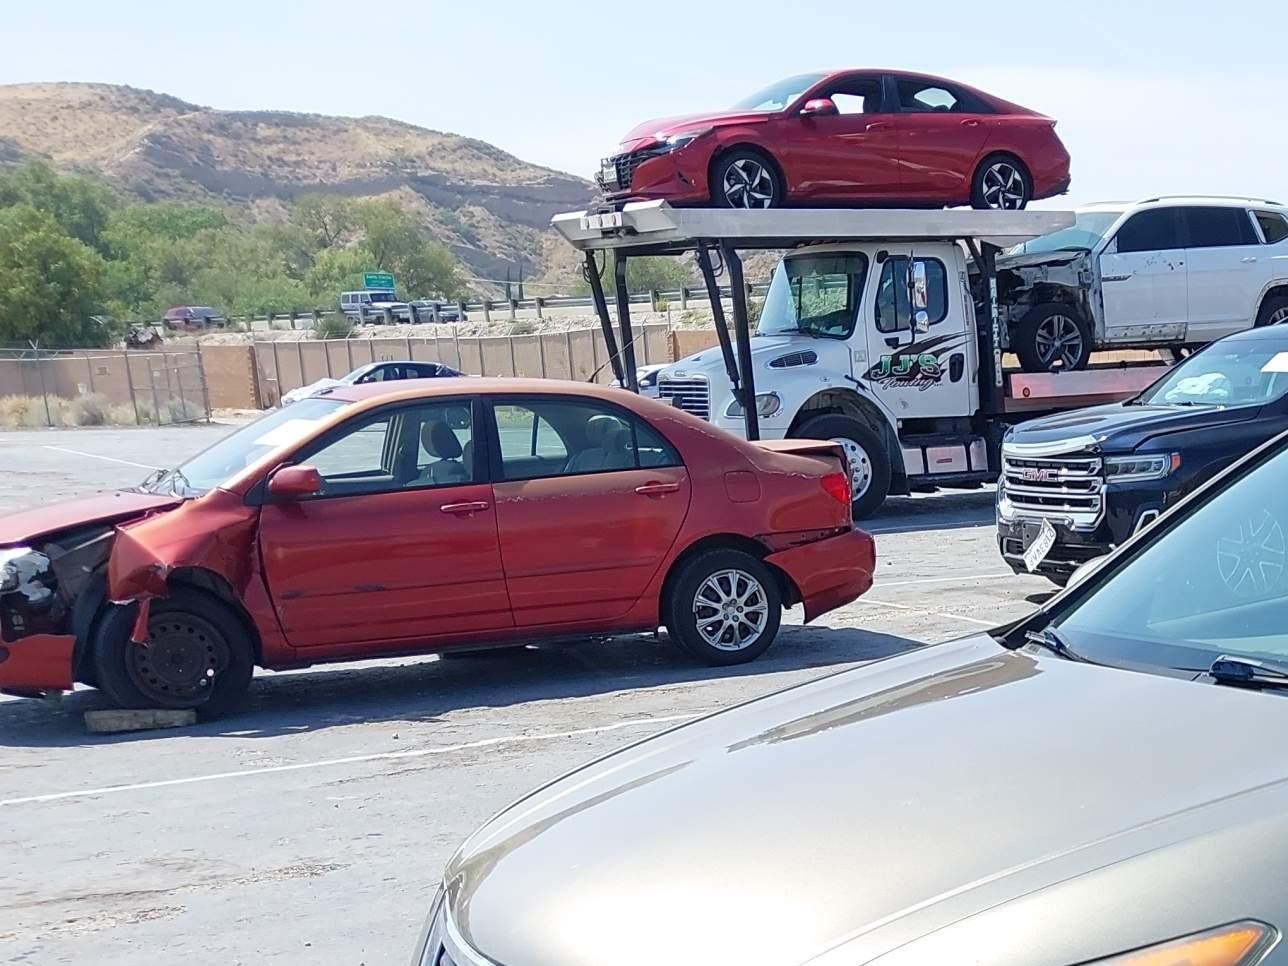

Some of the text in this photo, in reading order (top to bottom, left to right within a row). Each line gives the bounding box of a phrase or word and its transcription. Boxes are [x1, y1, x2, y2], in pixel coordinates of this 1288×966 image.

[871, 354, 941, 379] JJ'S
[878, 377, 935, 392] Towing
[1023, 467, 1059, 481] GMC
